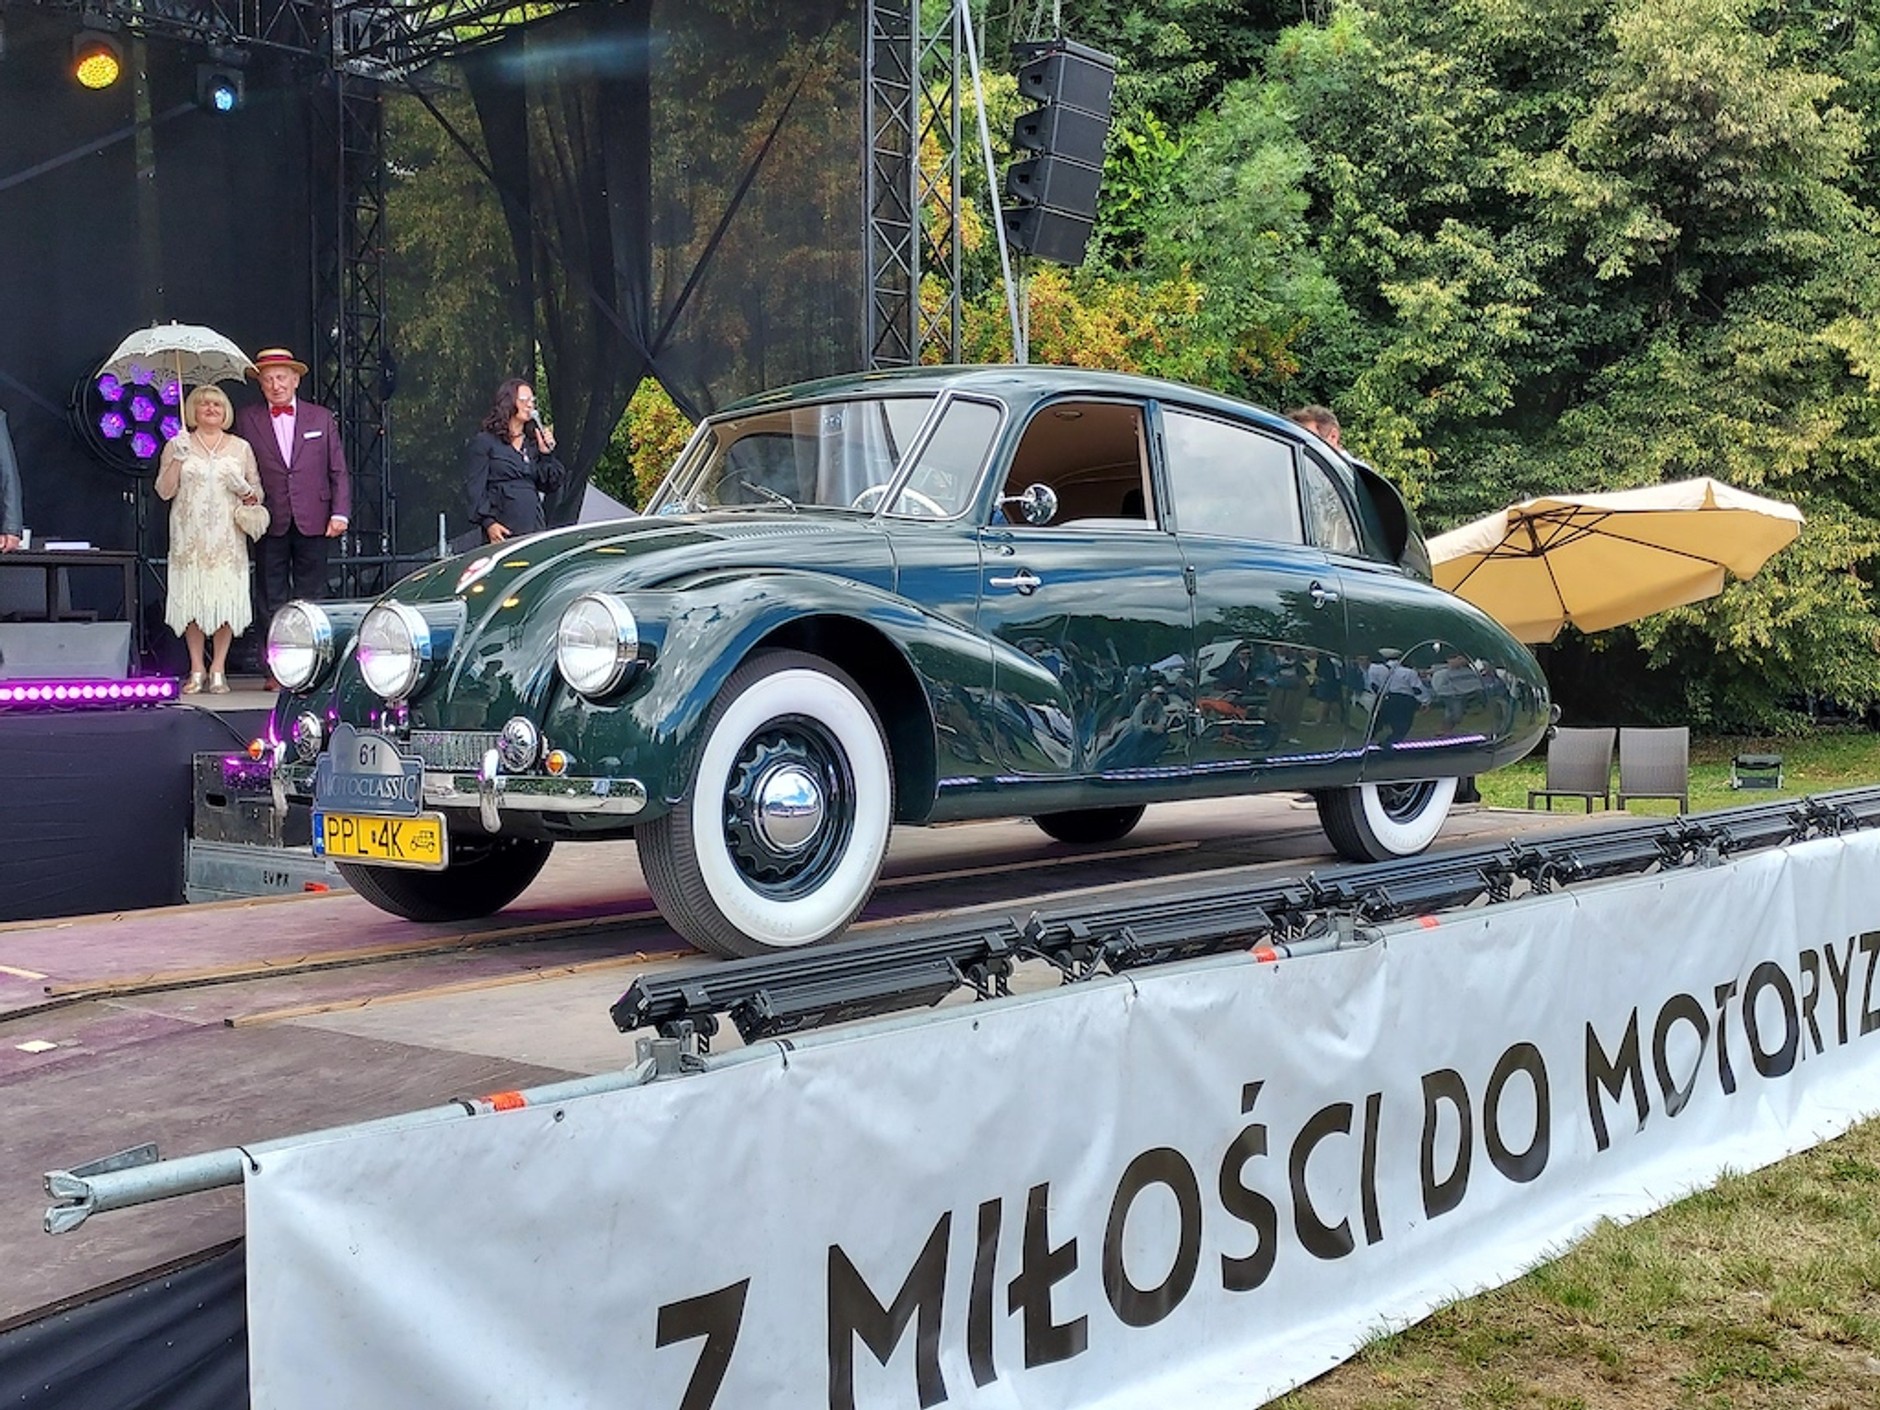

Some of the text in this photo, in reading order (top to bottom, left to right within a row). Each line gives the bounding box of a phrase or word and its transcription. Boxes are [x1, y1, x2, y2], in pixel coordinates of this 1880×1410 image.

[359, 743, 377, 766] 61
[319, 774, 417, 803] MOTOCLASSIC
[328, 816, 405, 858] PPL 4K
[827, 1079, 1385, 1410] MIŁOŚCI
[1420, 1041, 1552, 1220] DO
